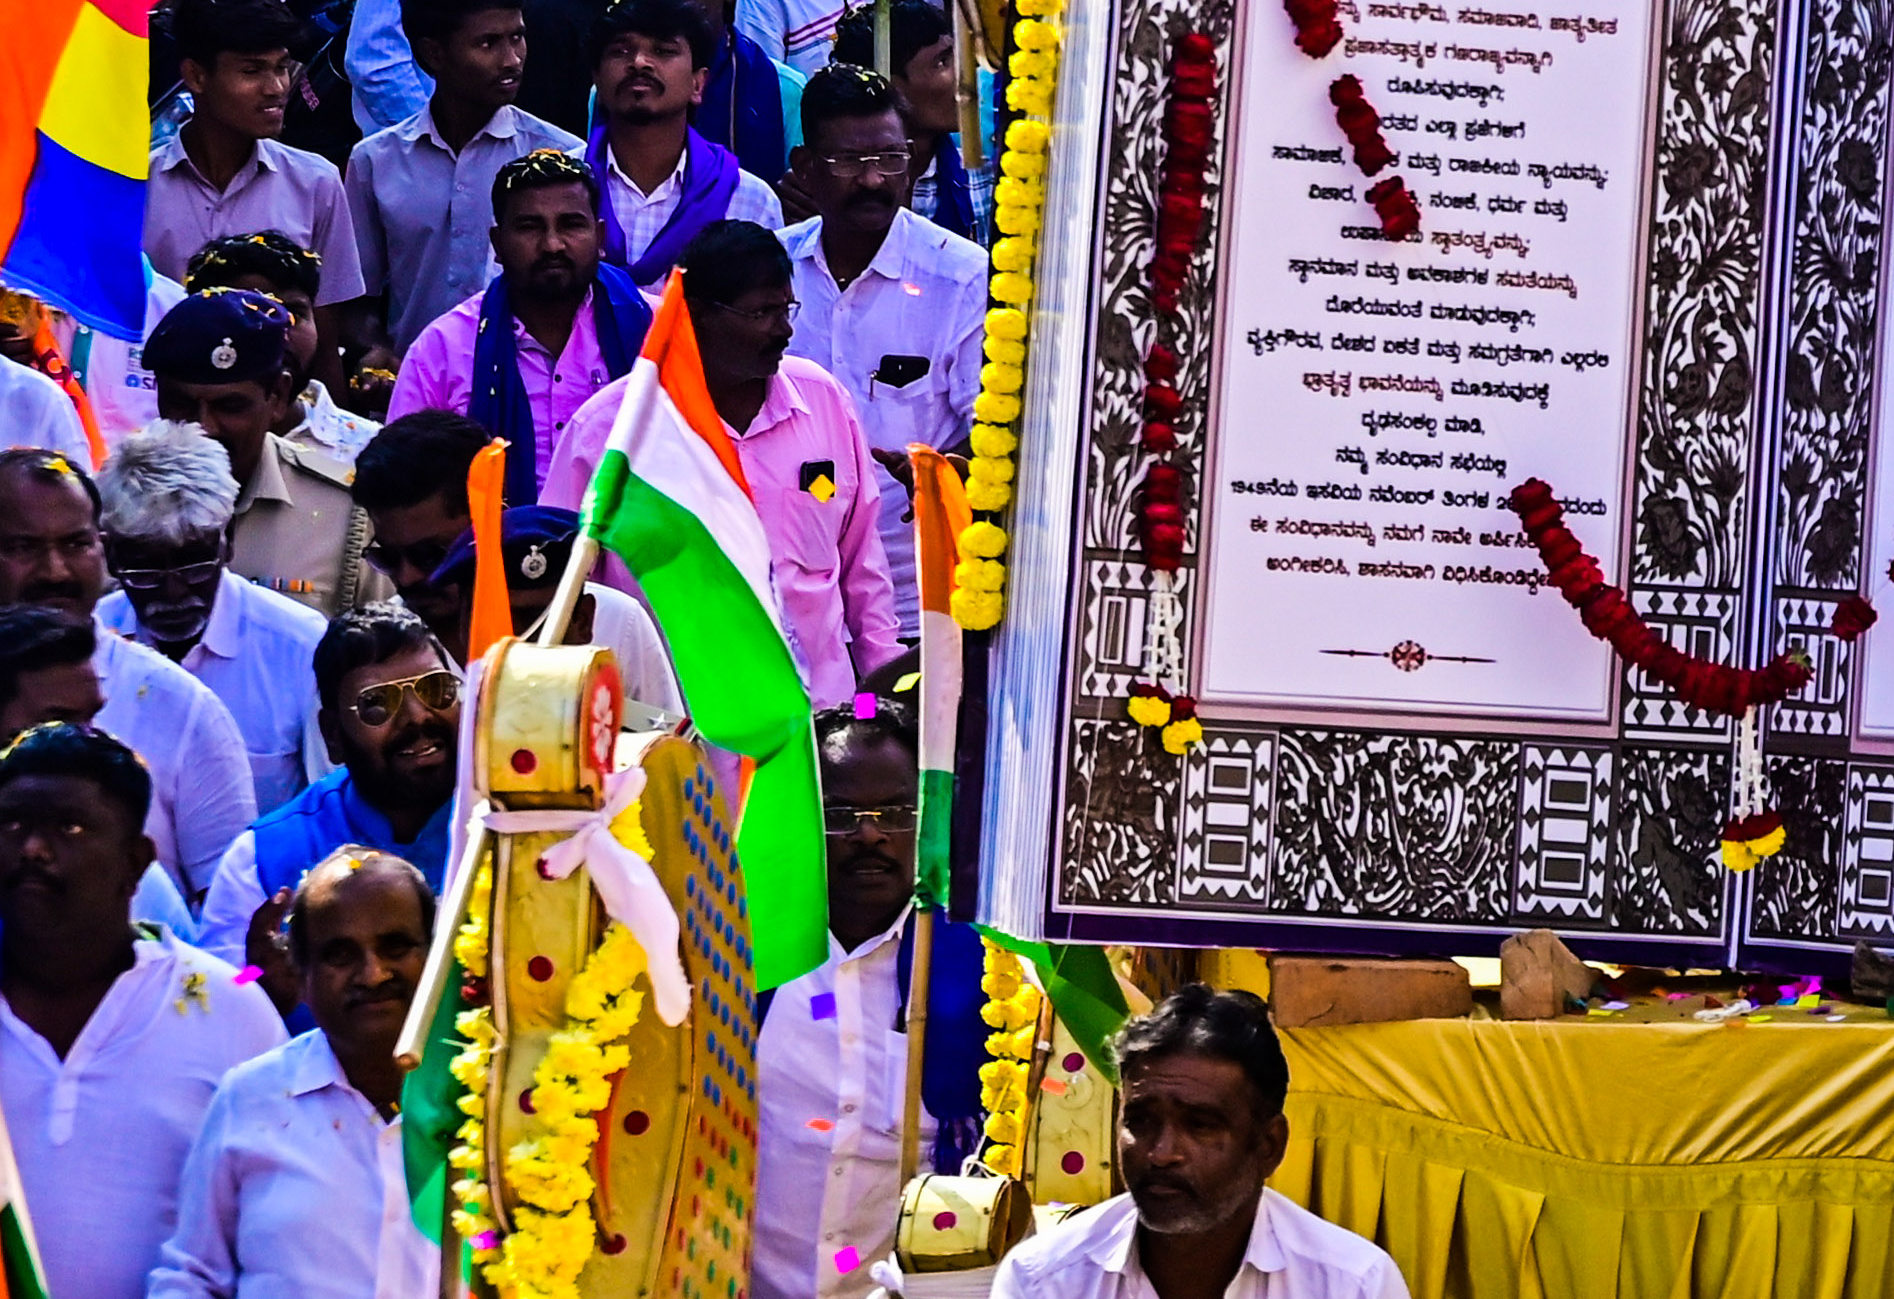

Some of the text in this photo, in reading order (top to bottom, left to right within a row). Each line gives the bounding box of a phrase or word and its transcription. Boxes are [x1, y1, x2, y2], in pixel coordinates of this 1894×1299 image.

[1365, 261, 1400, 286] ಮತ್ತು
[1335, 445, 1369, 475] ನಮ್ಮ
[1375, 448, 1444, 470] ಸಂವಿಧಾನ
[1382, 523, 1425, 542] ನಮಗೆ
